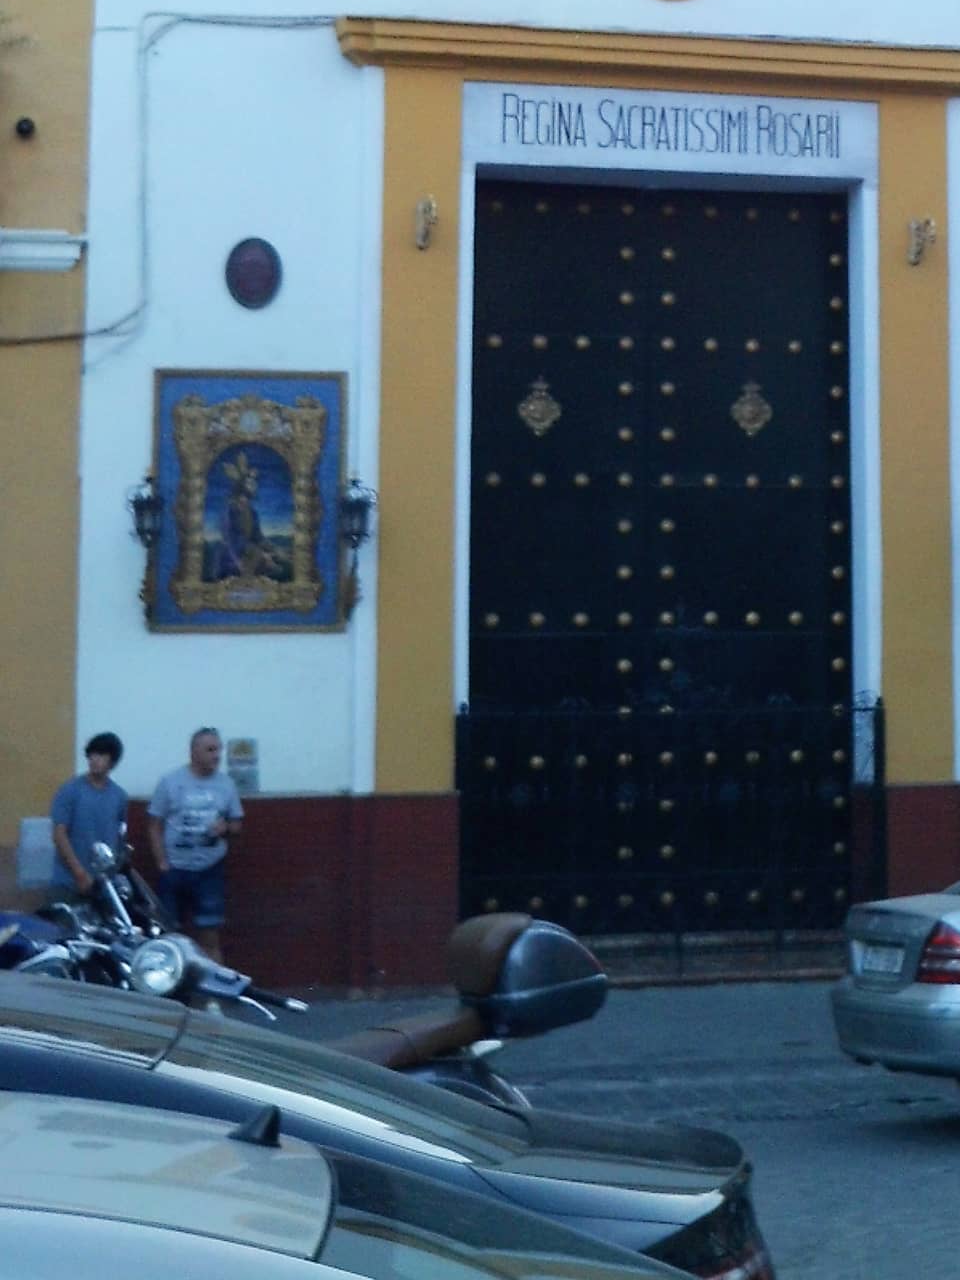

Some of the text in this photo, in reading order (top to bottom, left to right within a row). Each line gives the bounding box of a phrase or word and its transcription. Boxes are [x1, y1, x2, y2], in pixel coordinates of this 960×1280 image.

[502, 93, 840, 159] REGINA SACRATISSIMI ROSARII
